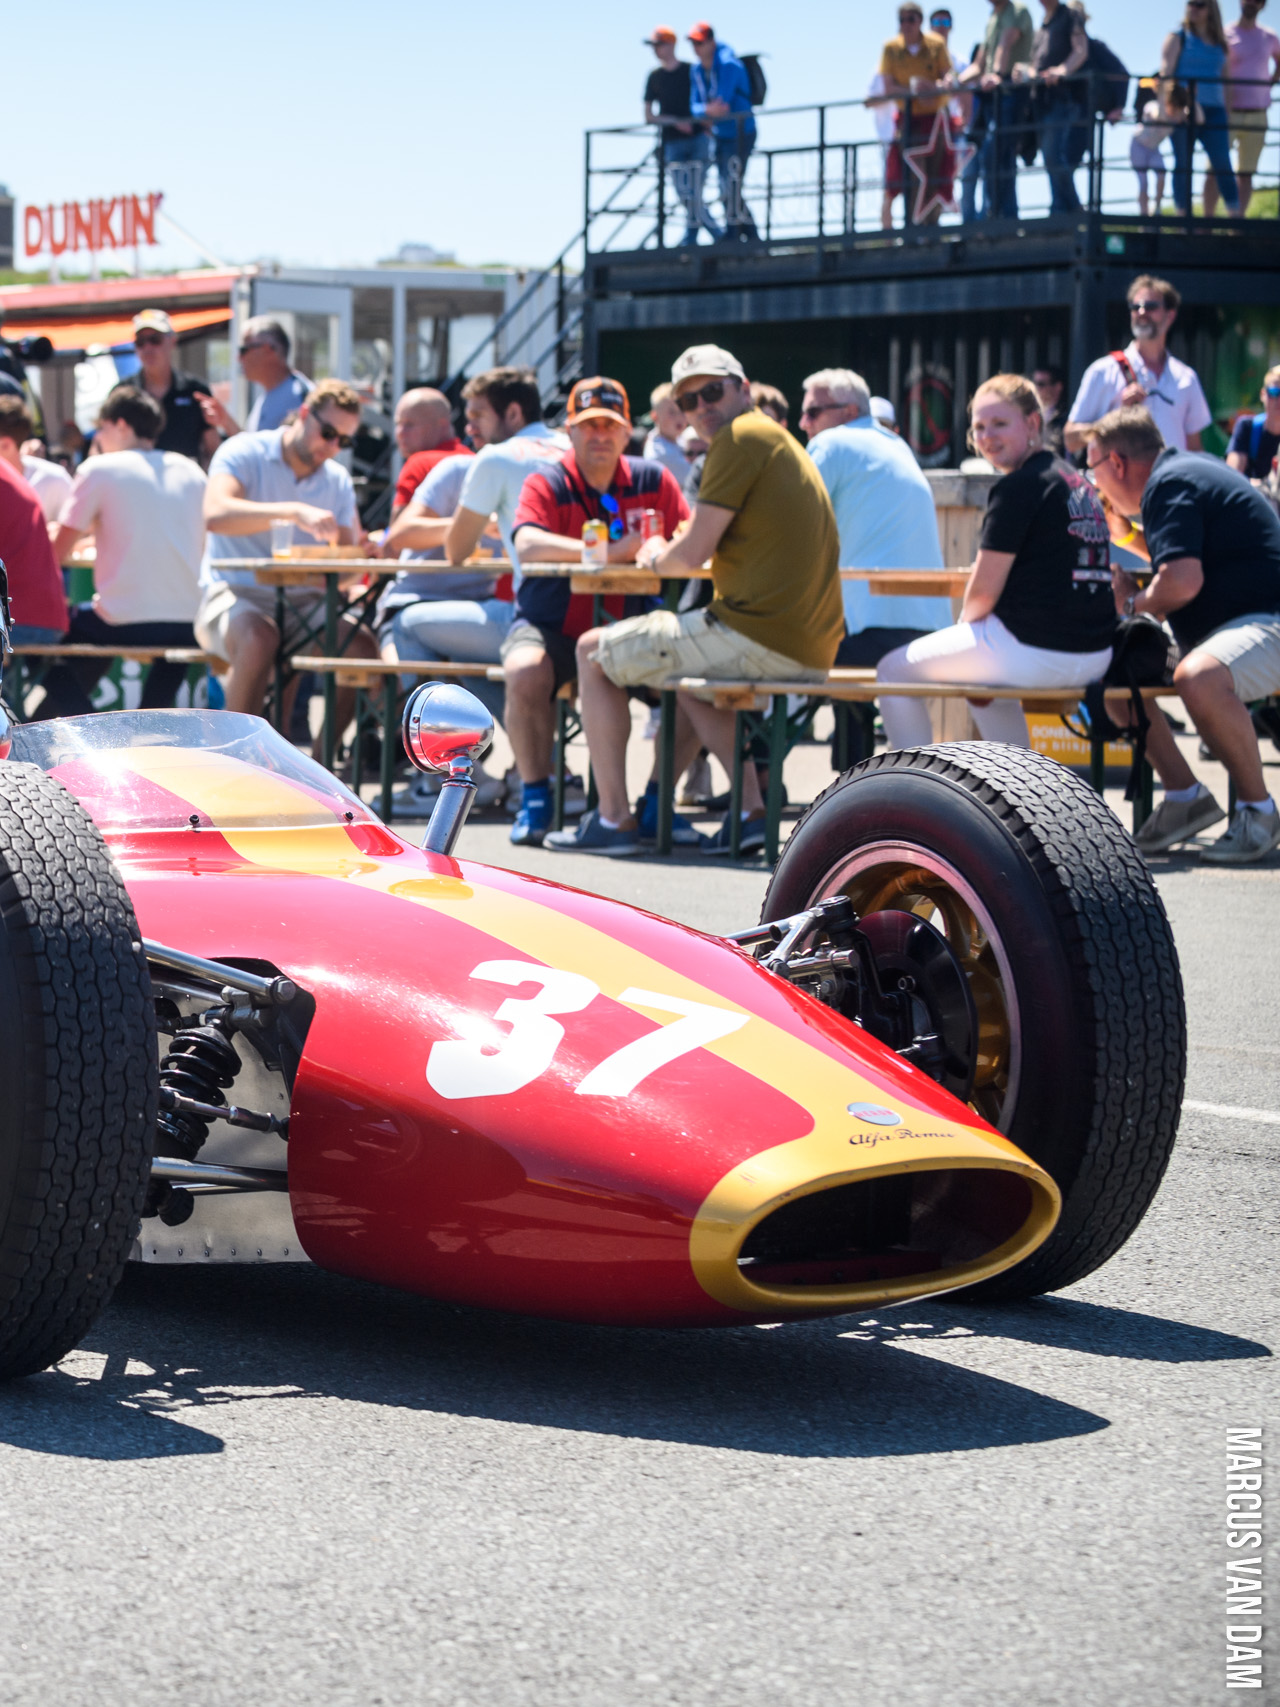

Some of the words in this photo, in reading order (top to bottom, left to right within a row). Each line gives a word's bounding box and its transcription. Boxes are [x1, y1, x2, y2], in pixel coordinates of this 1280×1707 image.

[24, 191, 163, 257] DUNKIN'
[426, 969, 751, 1099] 37
[849, 1131, 891, 1148] Alfa
[894, 1128, 956, 1139] Romeo
